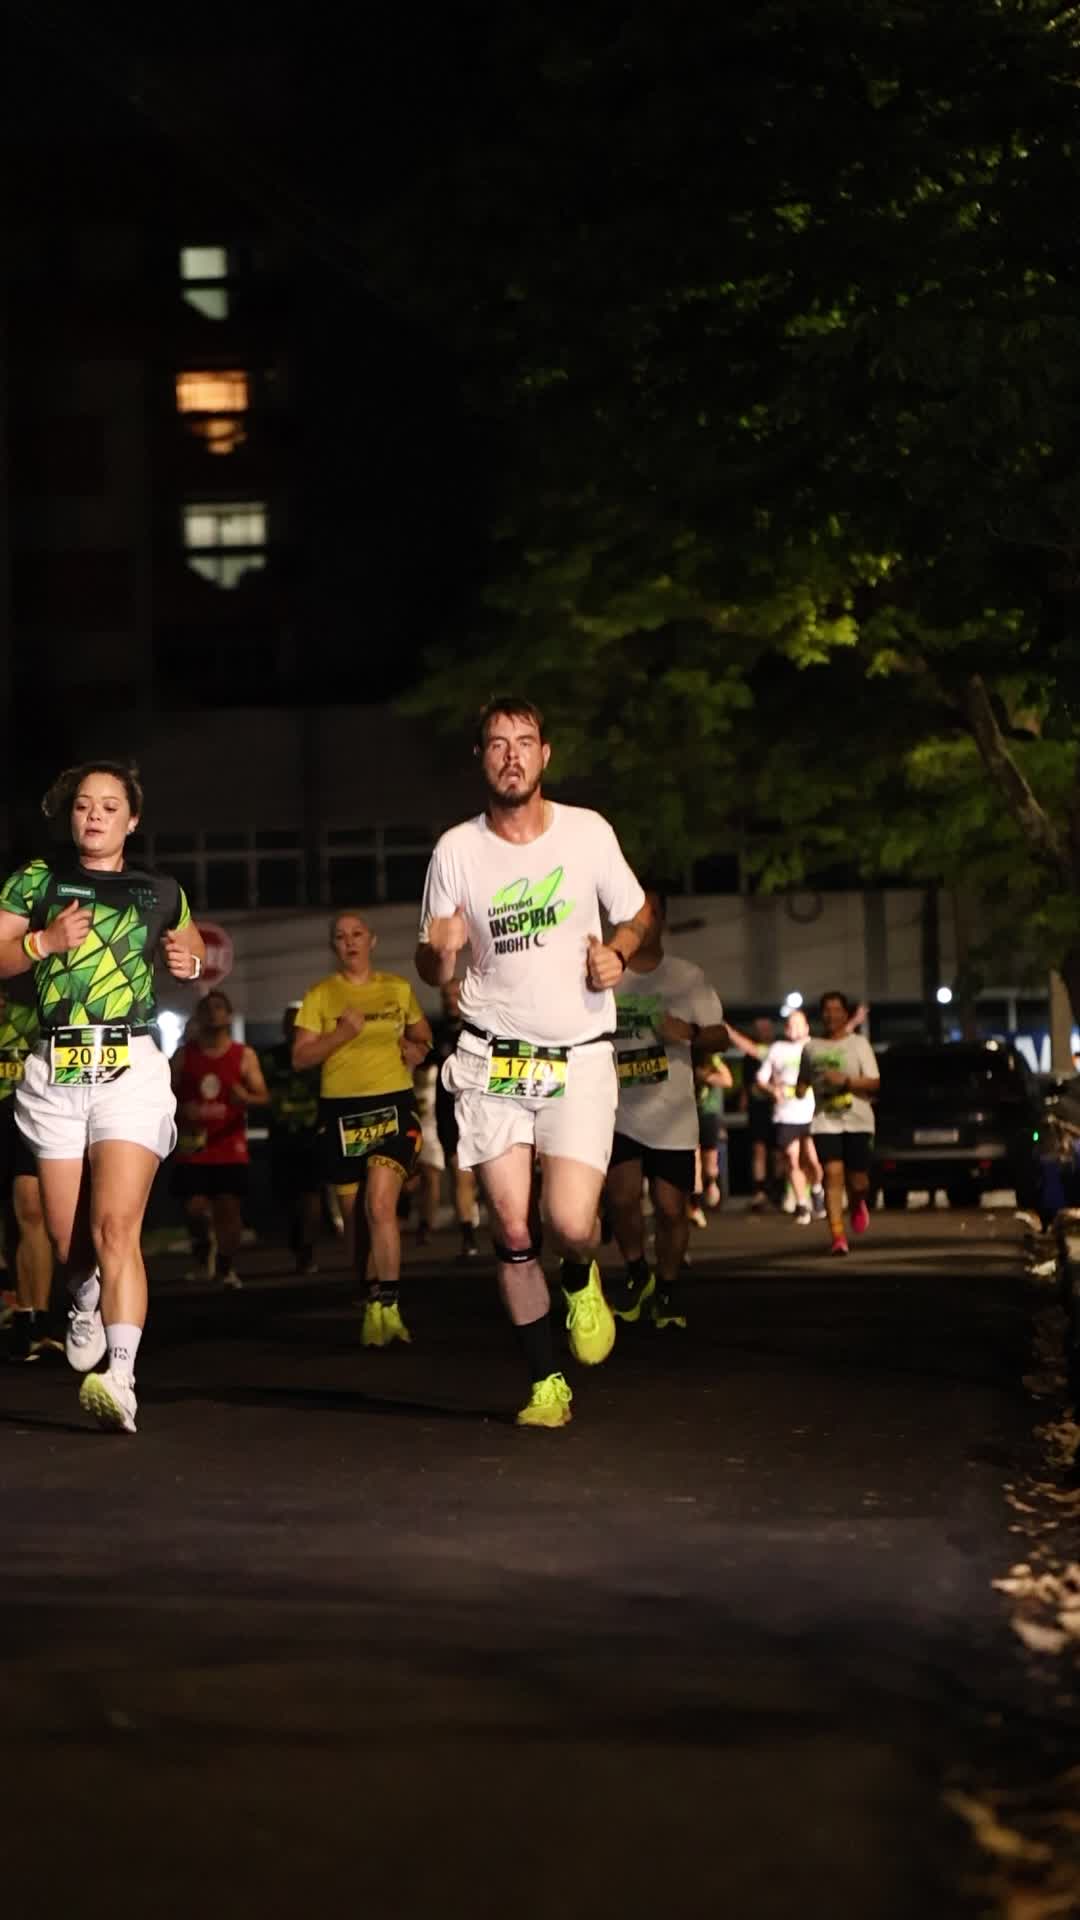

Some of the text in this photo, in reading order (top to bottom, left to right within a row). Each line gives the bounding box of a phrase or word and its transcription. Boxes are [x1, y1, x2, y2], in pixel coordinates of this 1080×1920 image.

[488, 896, 533, 917] Unimed
[489, 906, 557, 938] INSPIRA
[494, 933, 531, 955] NIGHT
